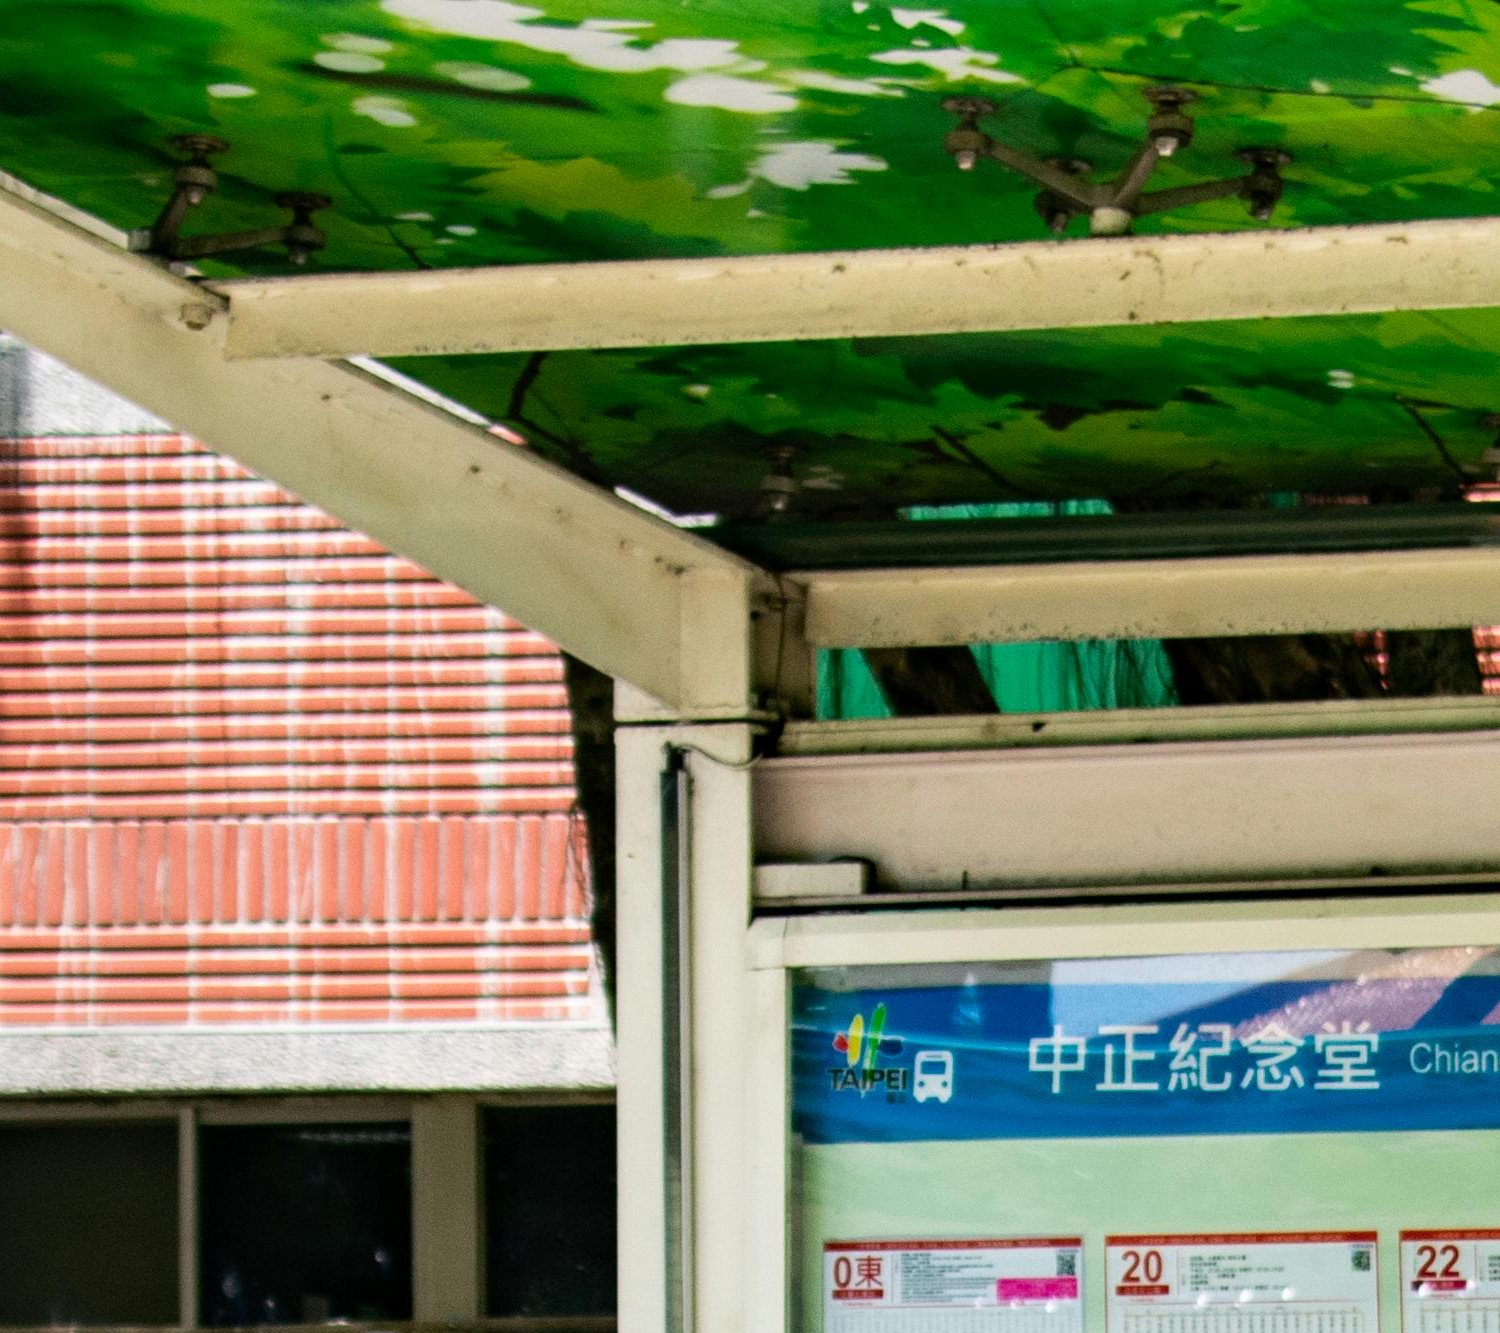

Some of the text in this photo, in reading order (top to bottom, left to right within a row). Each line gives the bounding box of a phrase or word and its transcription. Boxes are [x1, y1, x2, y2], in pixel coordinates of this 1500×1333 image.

[1028, 1020, 1381, 1094] 中正紀念堂
[826, 1067, 909, 1092] TAIPEI
[833, 1255, 884, 1290] 0東
[1121, 1249, 1163, 1283] 20
[1416, 1244, 1460, 1279] 22
